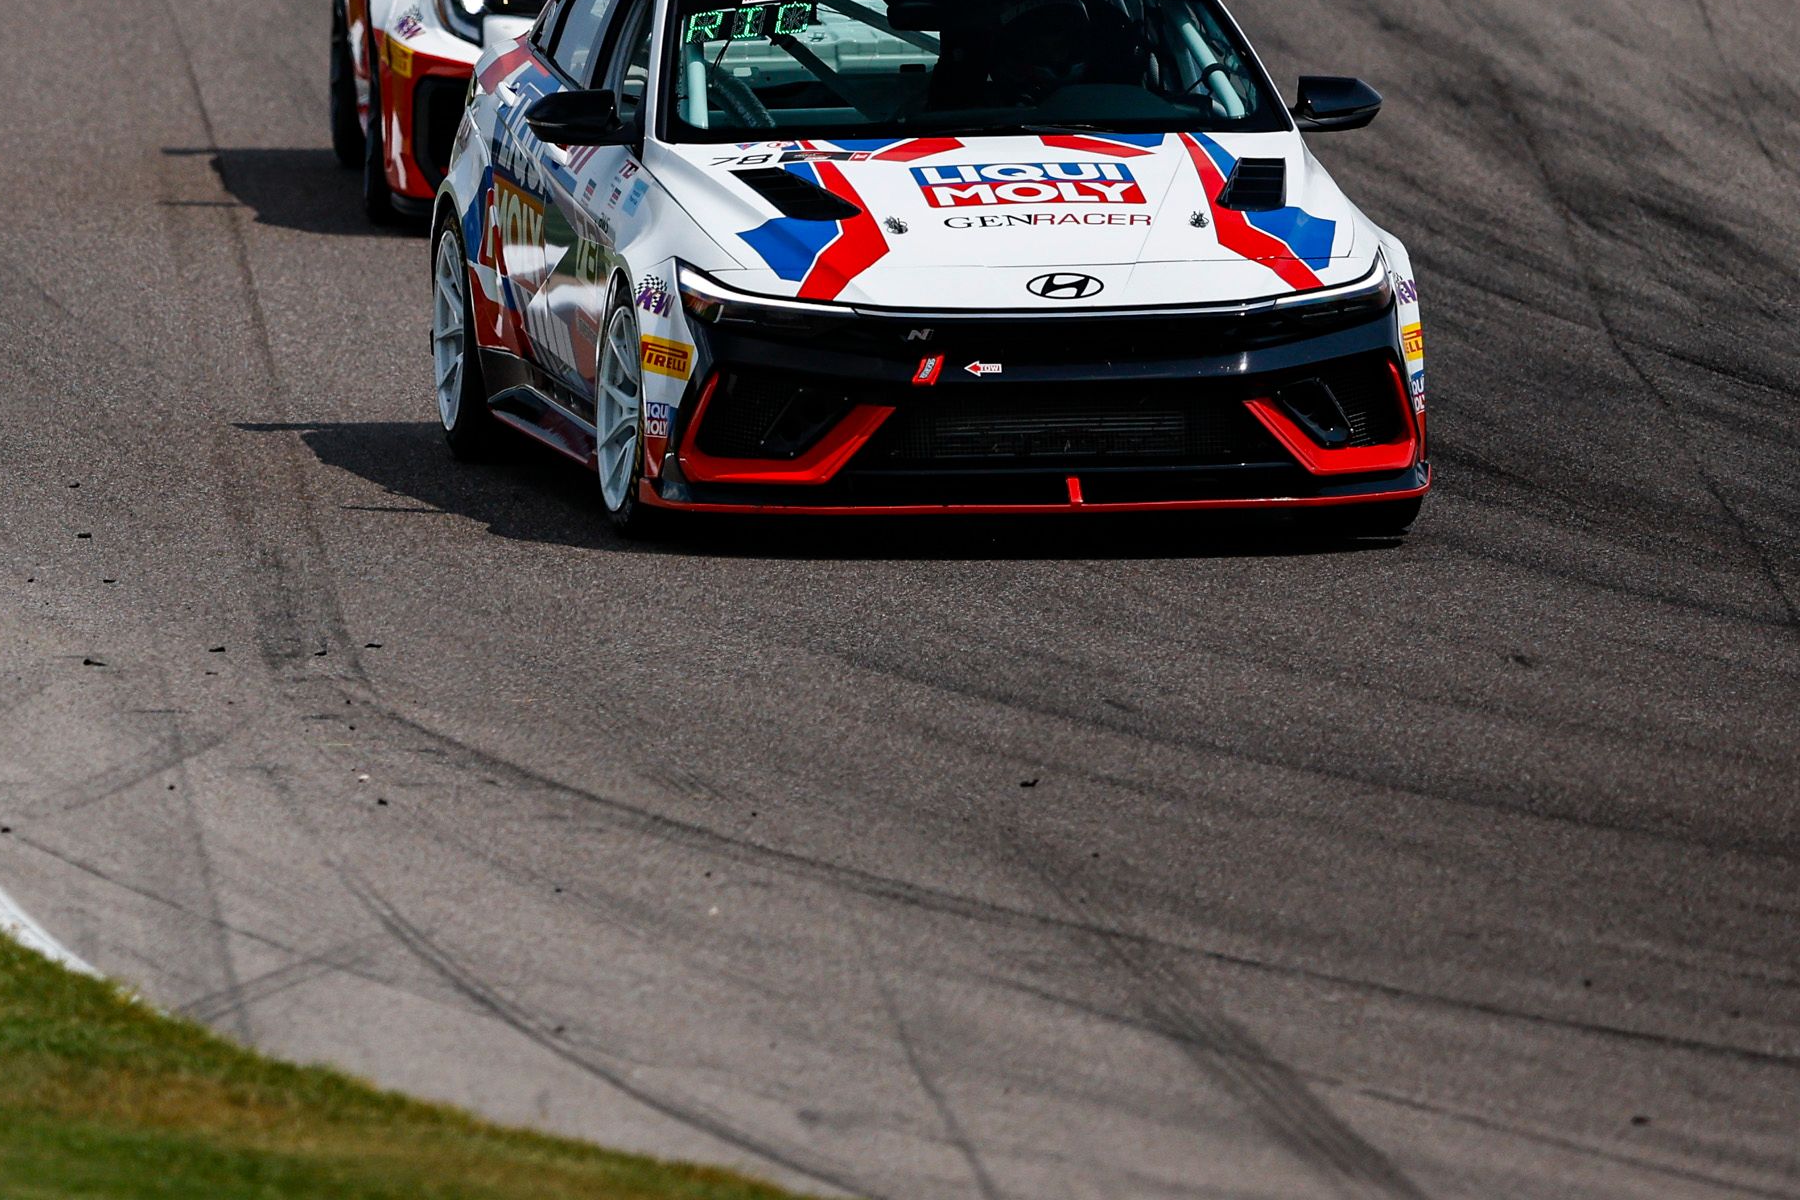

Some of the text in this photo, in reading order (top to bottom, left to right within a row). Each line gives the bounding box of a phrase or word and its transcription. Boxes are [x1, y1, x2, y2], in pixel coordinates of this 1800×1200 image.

[686, 1, 813, 43] RIC
[709, 153, 773, 166] 78
[920, 163, 1125, 185] LIQUI
[931, 182, 1136, 207] MOLY
[943, 213, 1152, 229] GENRACER
[641, 340, 689, 373] PIRELLI
[981, 364, 1001, 372] TOW
